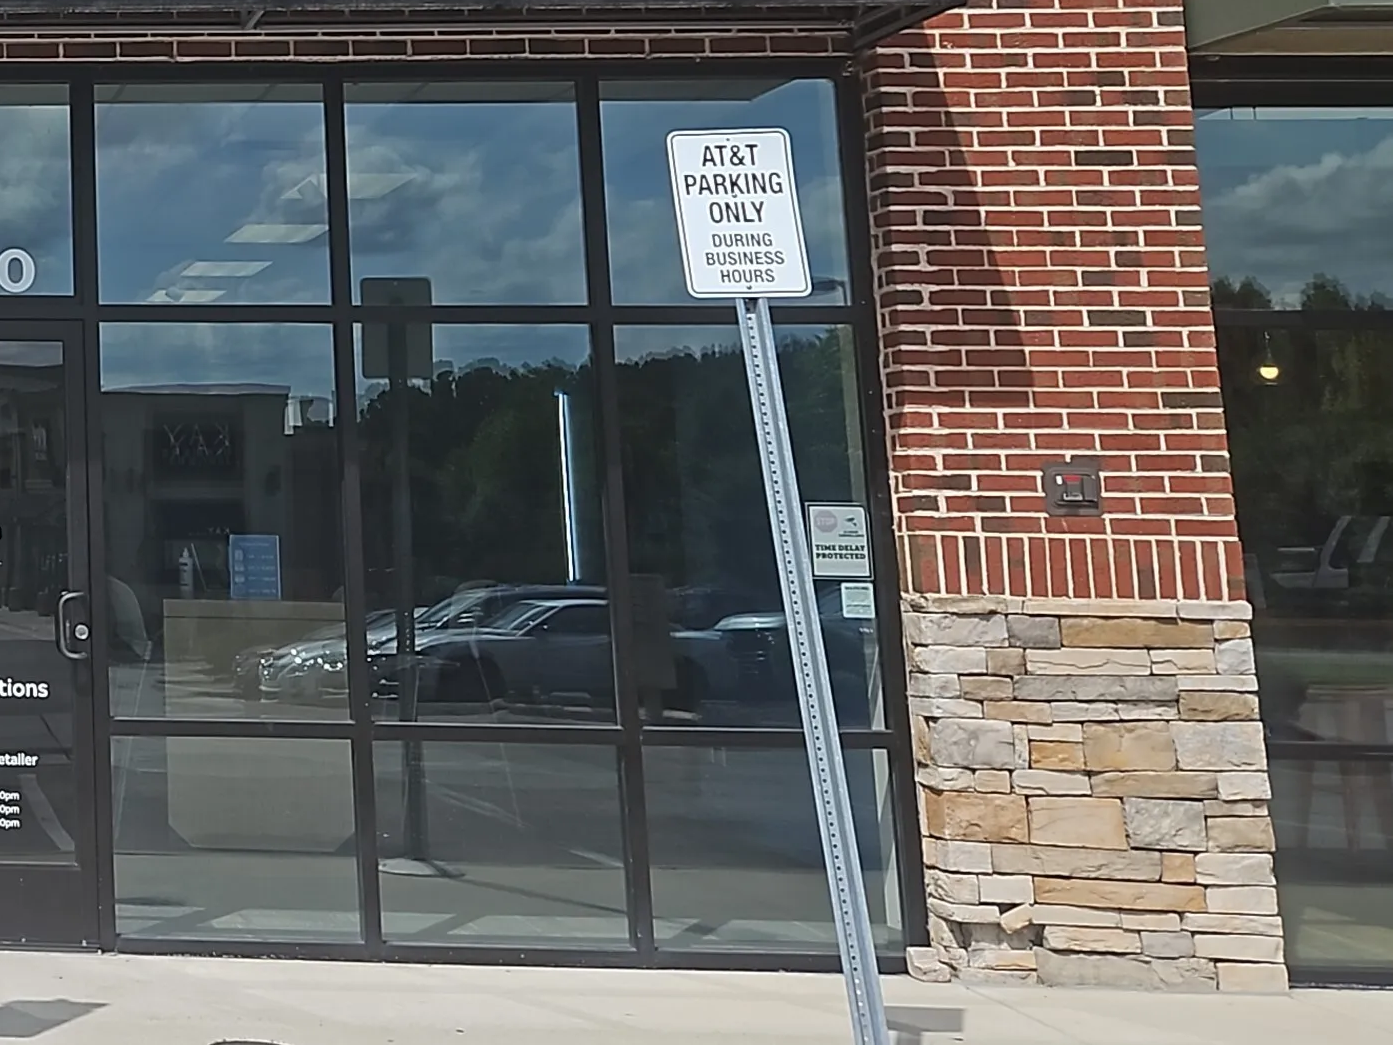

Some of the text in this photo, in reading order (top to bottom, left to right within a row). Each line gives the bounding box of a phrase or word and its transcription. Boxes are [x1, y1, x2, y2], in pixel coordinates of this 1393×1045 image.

[702, 144, 758, 167] AT&T
[684, 172, 784, 195] PARKING
[709, 201, 764, 223] ONLY
[712, 233, 773, 247] DURING
[705, 251, 785, 266] BUSINESS
[720, 269, 775, 283] HOURS
